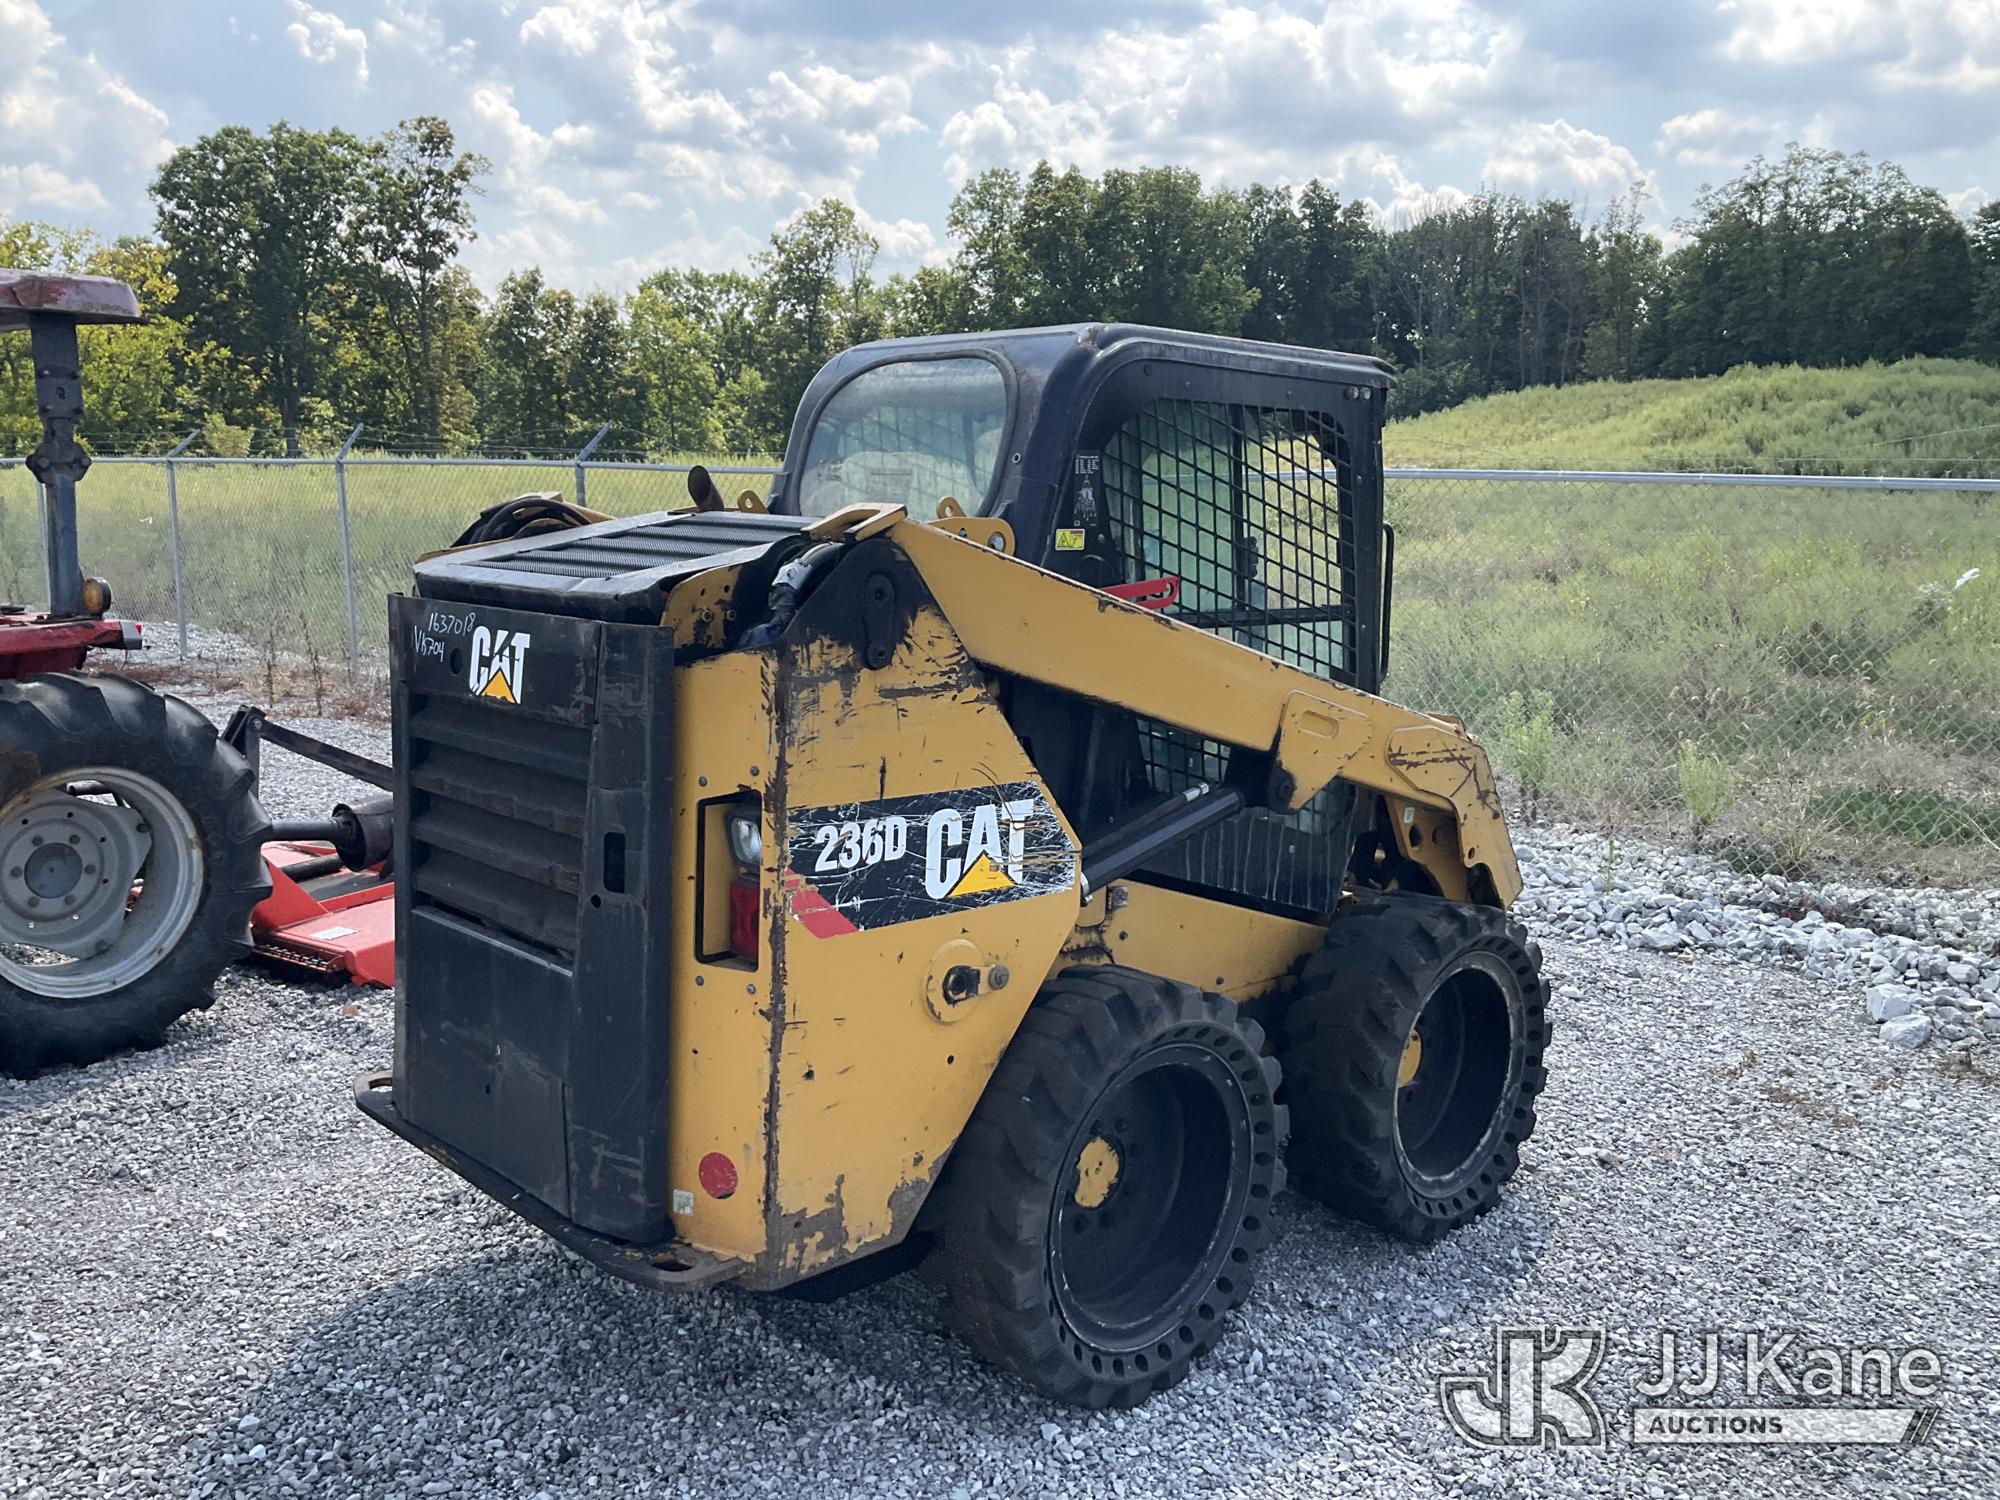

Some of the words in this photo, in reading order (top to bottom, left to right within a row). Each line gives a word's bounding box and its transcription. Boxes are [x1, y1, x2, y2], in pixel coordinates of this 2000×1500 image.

[428, 612, 476, 637] 1637018
[469, 625, 531, 704] CAT
[815, 815, 907, 872] 236D
[925, 799, 1034, 899] CAT
